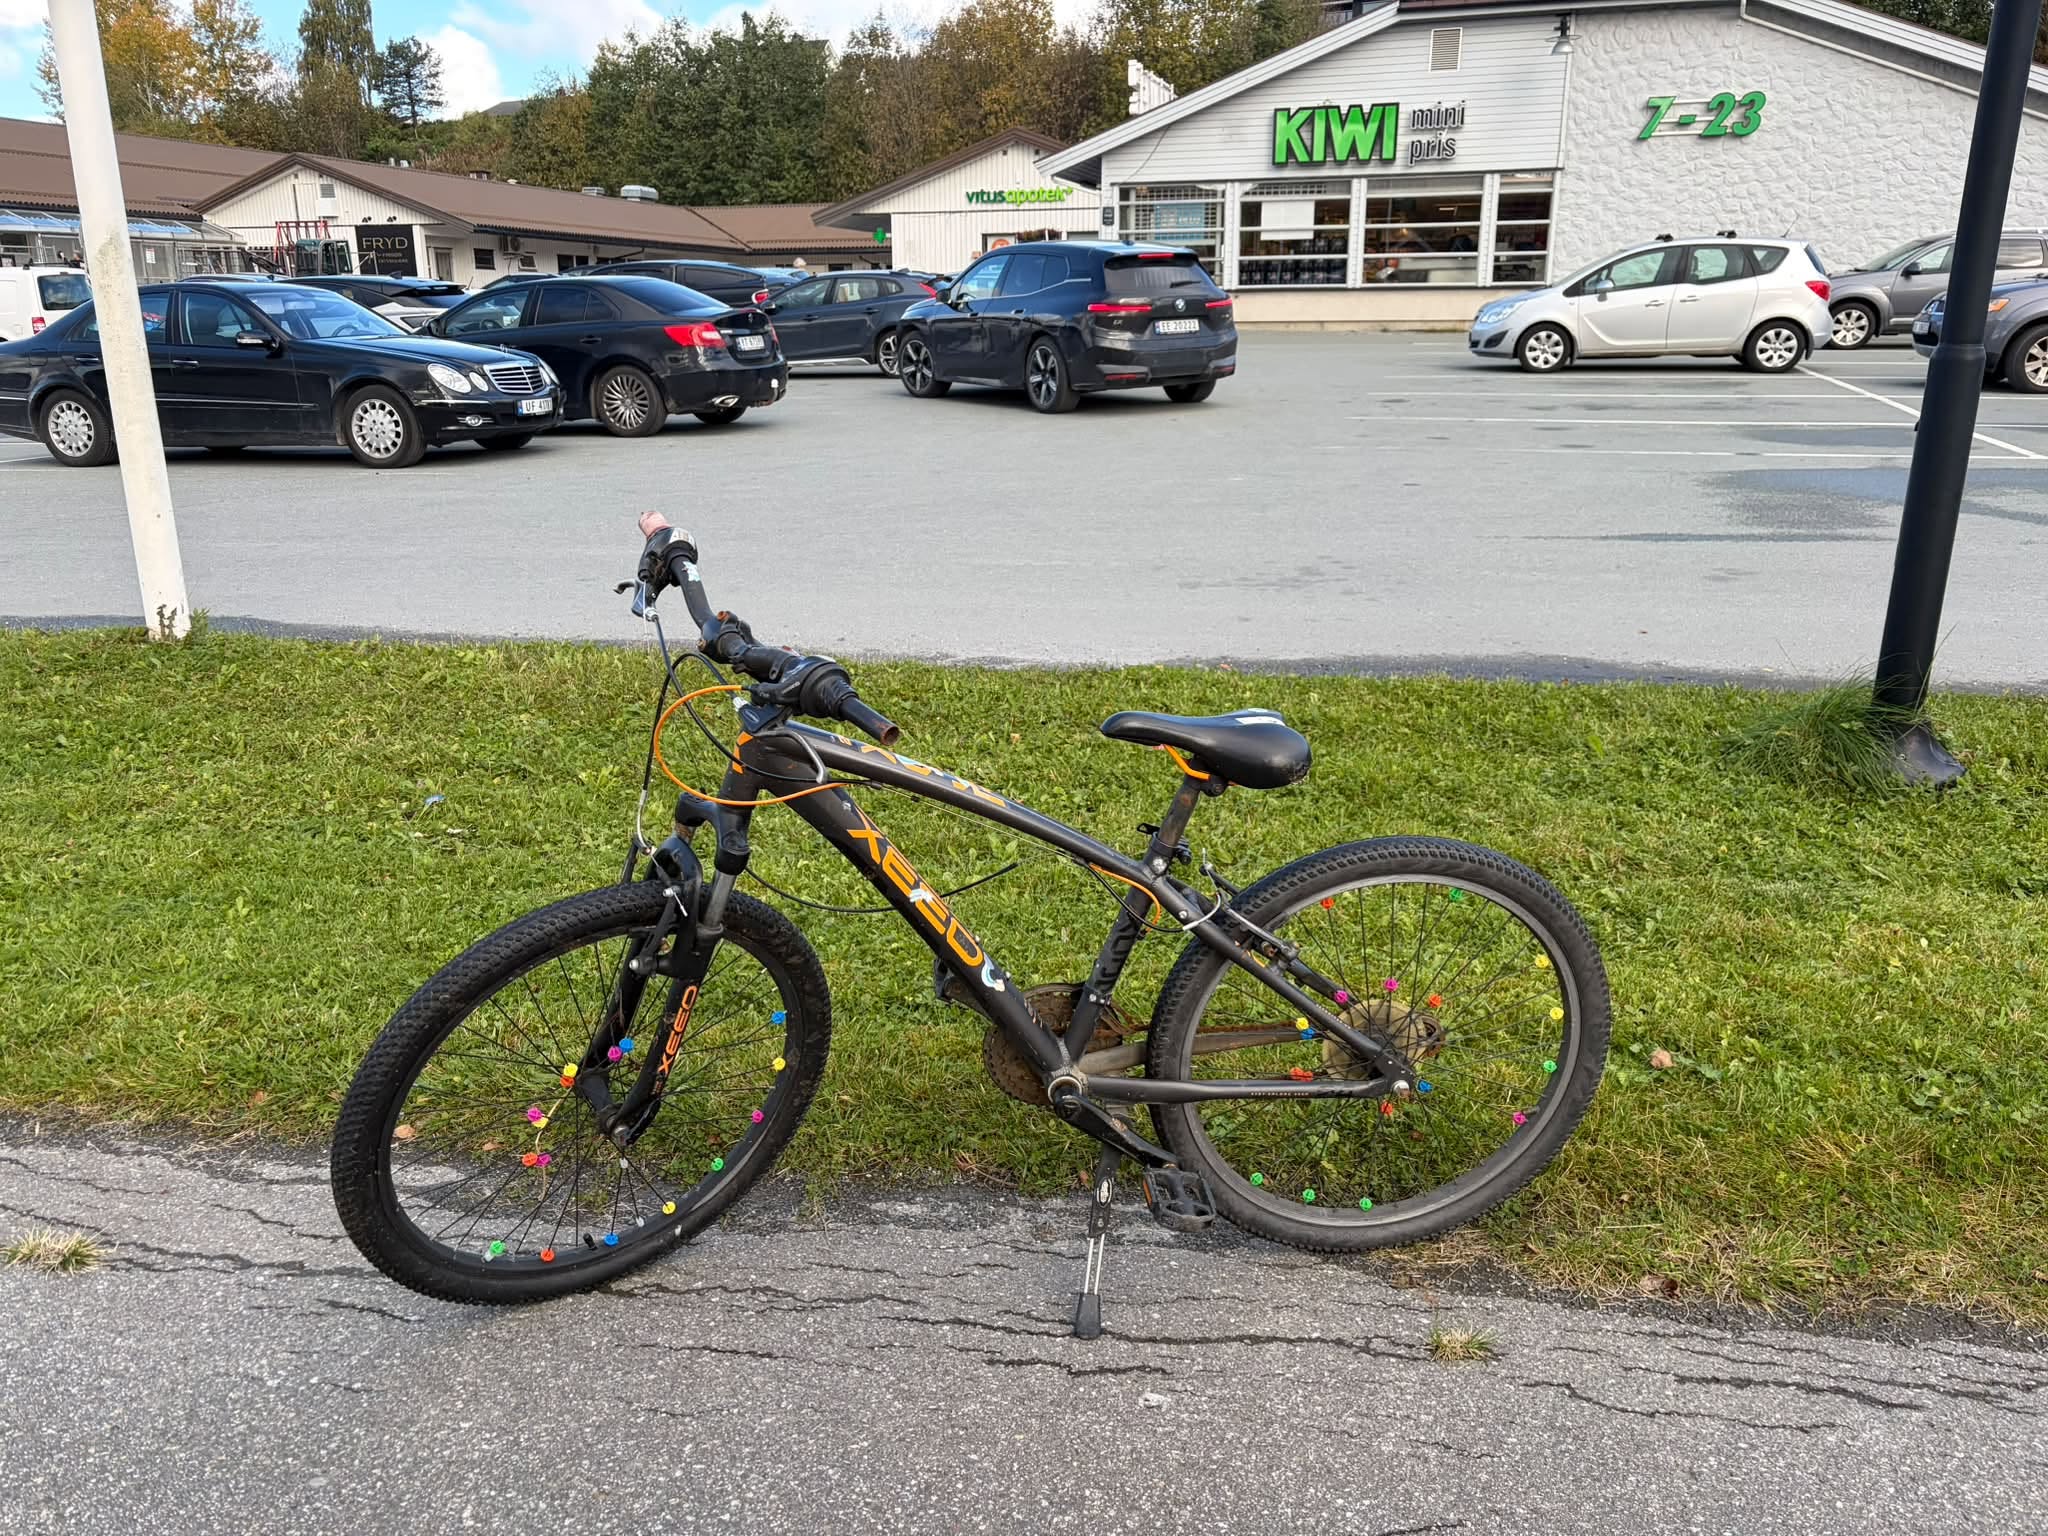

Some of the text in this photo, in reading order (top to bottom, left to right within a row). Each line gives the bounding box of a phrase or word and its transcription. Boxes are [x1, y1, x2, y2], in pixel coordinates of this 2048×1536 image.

[1410, 100, 1467, 130] mini
[1273, 102, 1400, 166] KIWI
[1408, 131, 1457, 167] pris
[362, 236, 408, 249] FRYD
[525, 400, 536, 411] UF
[847, 802, 984, 967] XEED
[658, 985, 698, 1074] XEED
